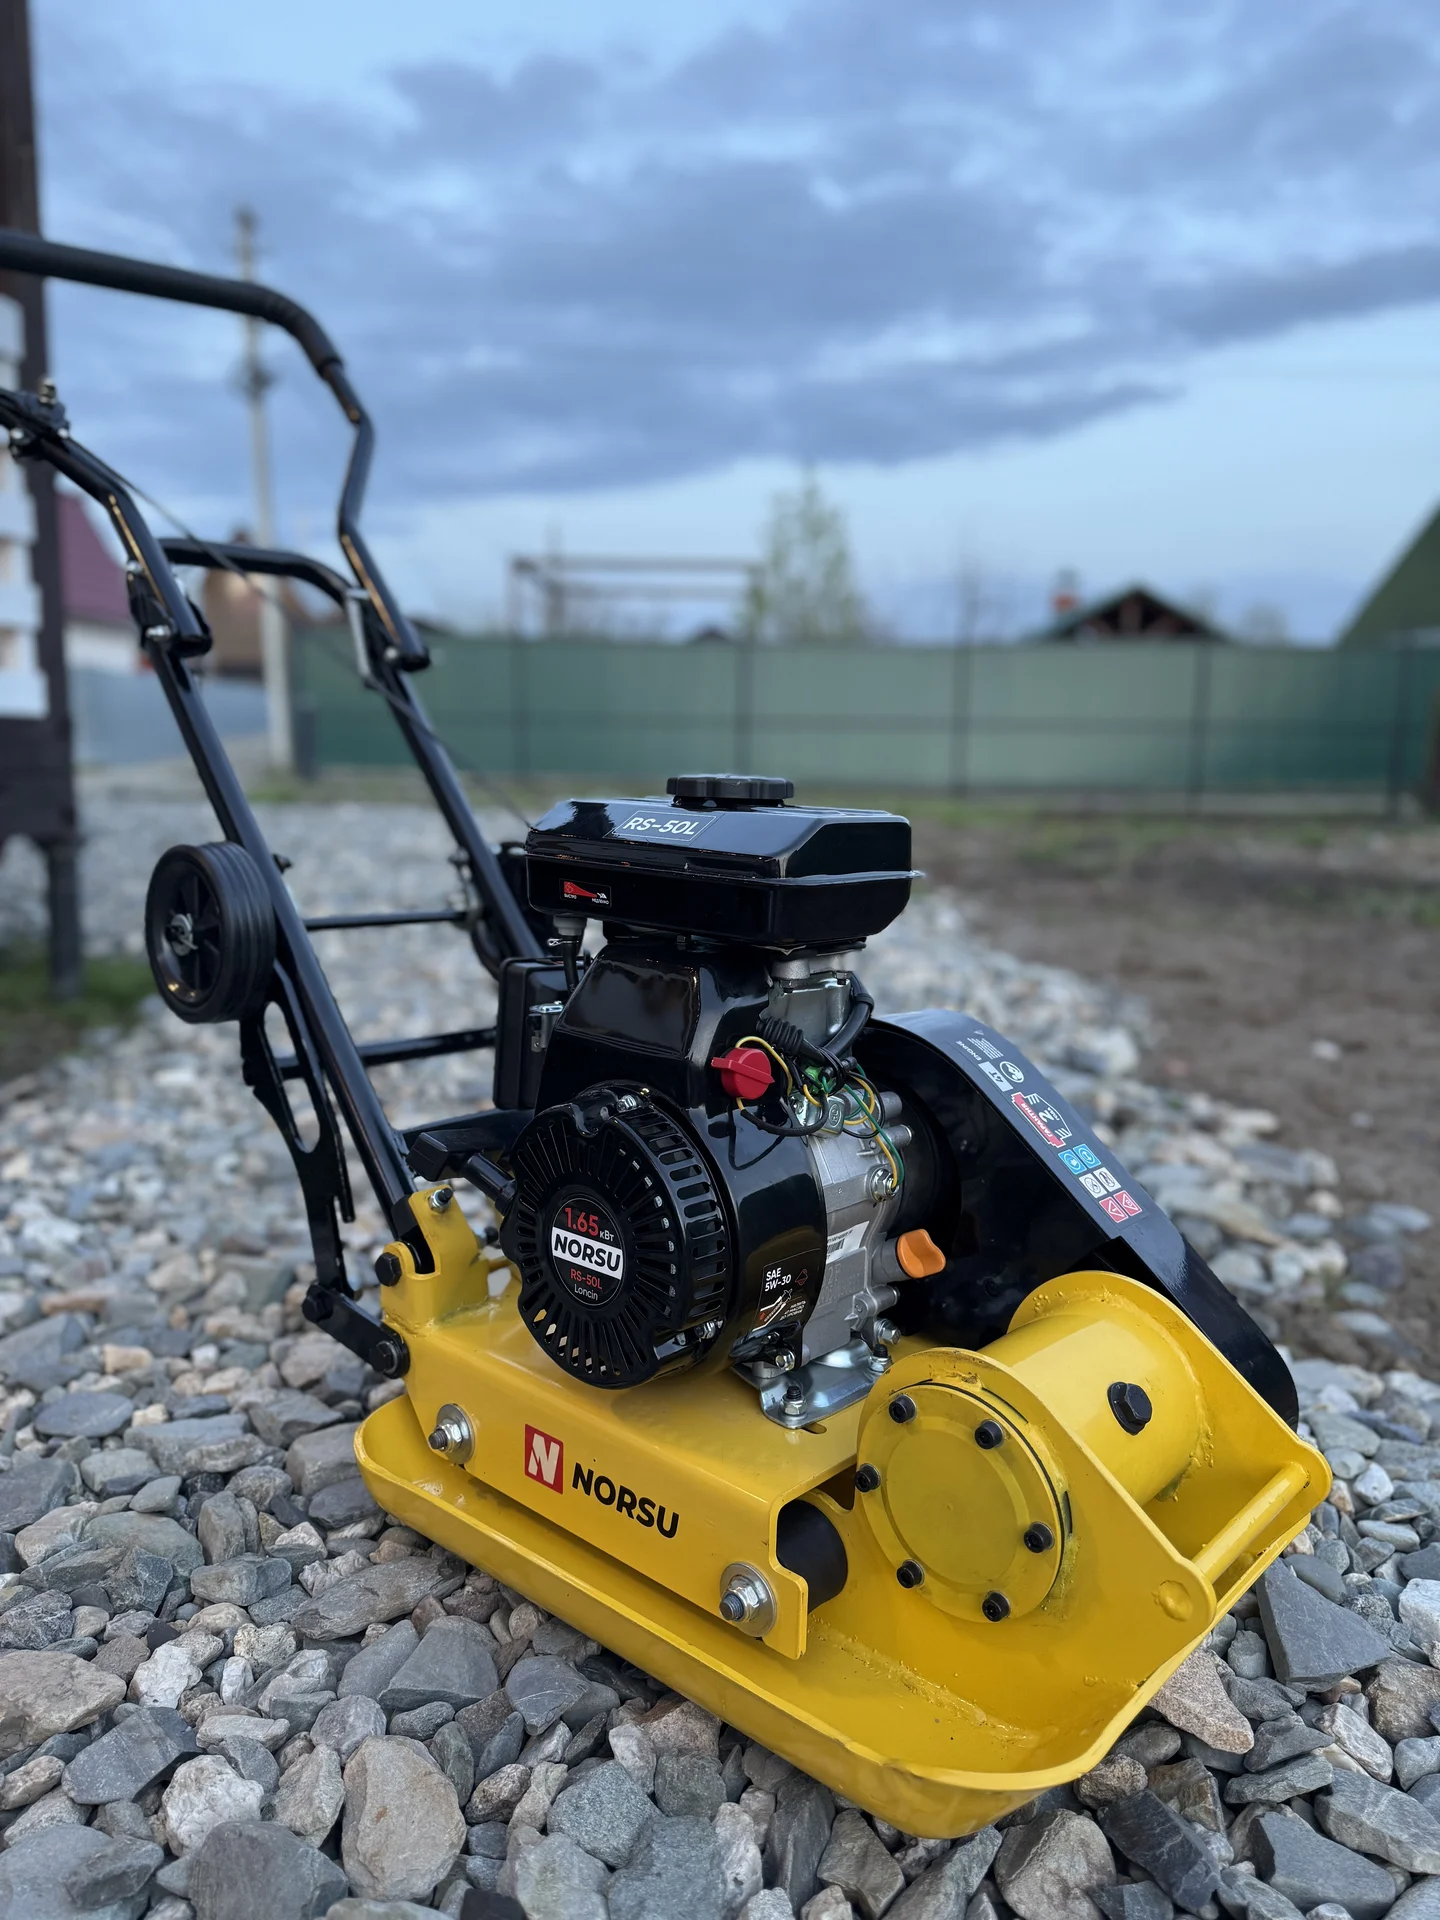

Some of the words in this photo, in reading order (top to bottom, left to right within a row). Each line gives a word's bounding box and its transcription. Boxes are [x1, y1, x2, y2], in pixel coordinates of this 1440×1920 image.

[623, 817, 699, 835] RS-50L
[1021, 1103, 1053, 1137] ГАРАНТИЯ
[1038, 1109, 1055, 1123] 2
[565, 1207, 599, 1236] 1.65
[599, 1229, 615, 1242] кВт
[554, 1233, 621, 1272] NORSU
[570, 1268, 603, 1290] RS-50L
[764, 1273, 792, 1292] 5W-30
[765, 1267, 782, 1281] SAE
[574, 1283, 599, 1301] Loncin
[572, 1462, 679, 1538] NORSU
